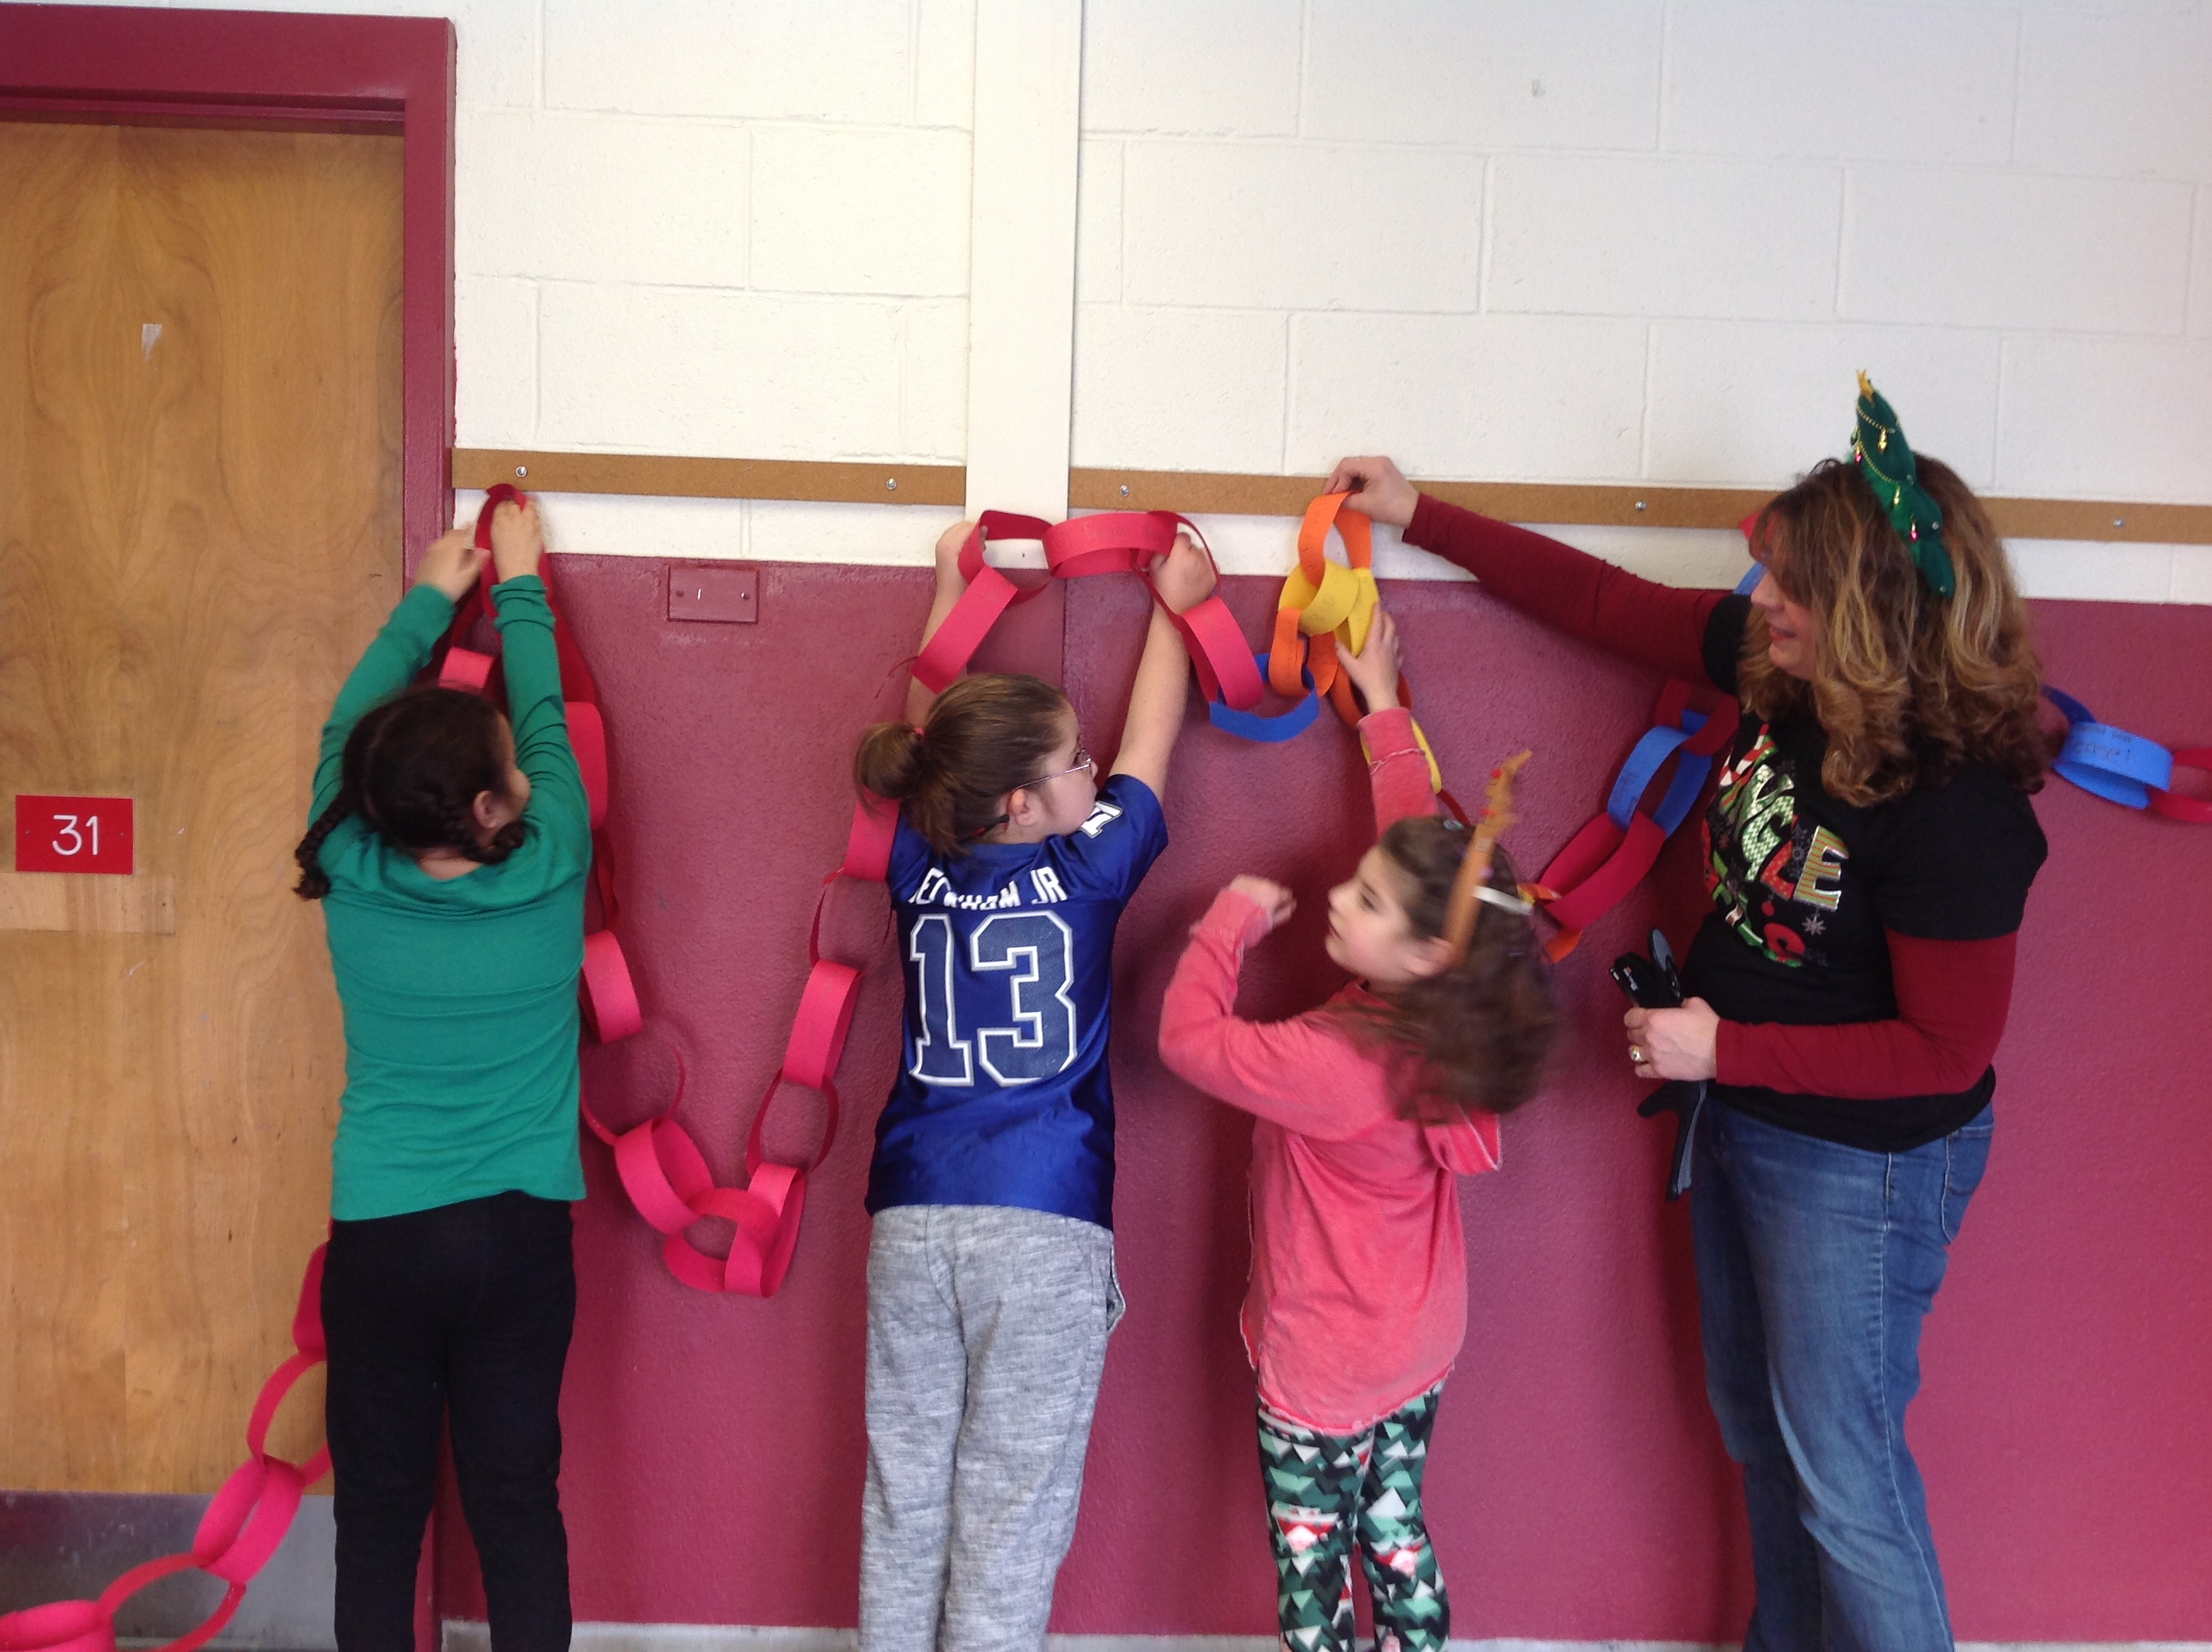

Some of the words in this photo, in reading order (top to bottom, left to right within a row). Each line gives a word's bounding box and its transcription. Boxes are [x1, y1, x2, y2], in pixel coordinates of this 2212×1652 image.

[52, 815, 99, 855] 31
[1030, 866, 1068, 905] JR
[909, 910, 1077, 1087] 13
